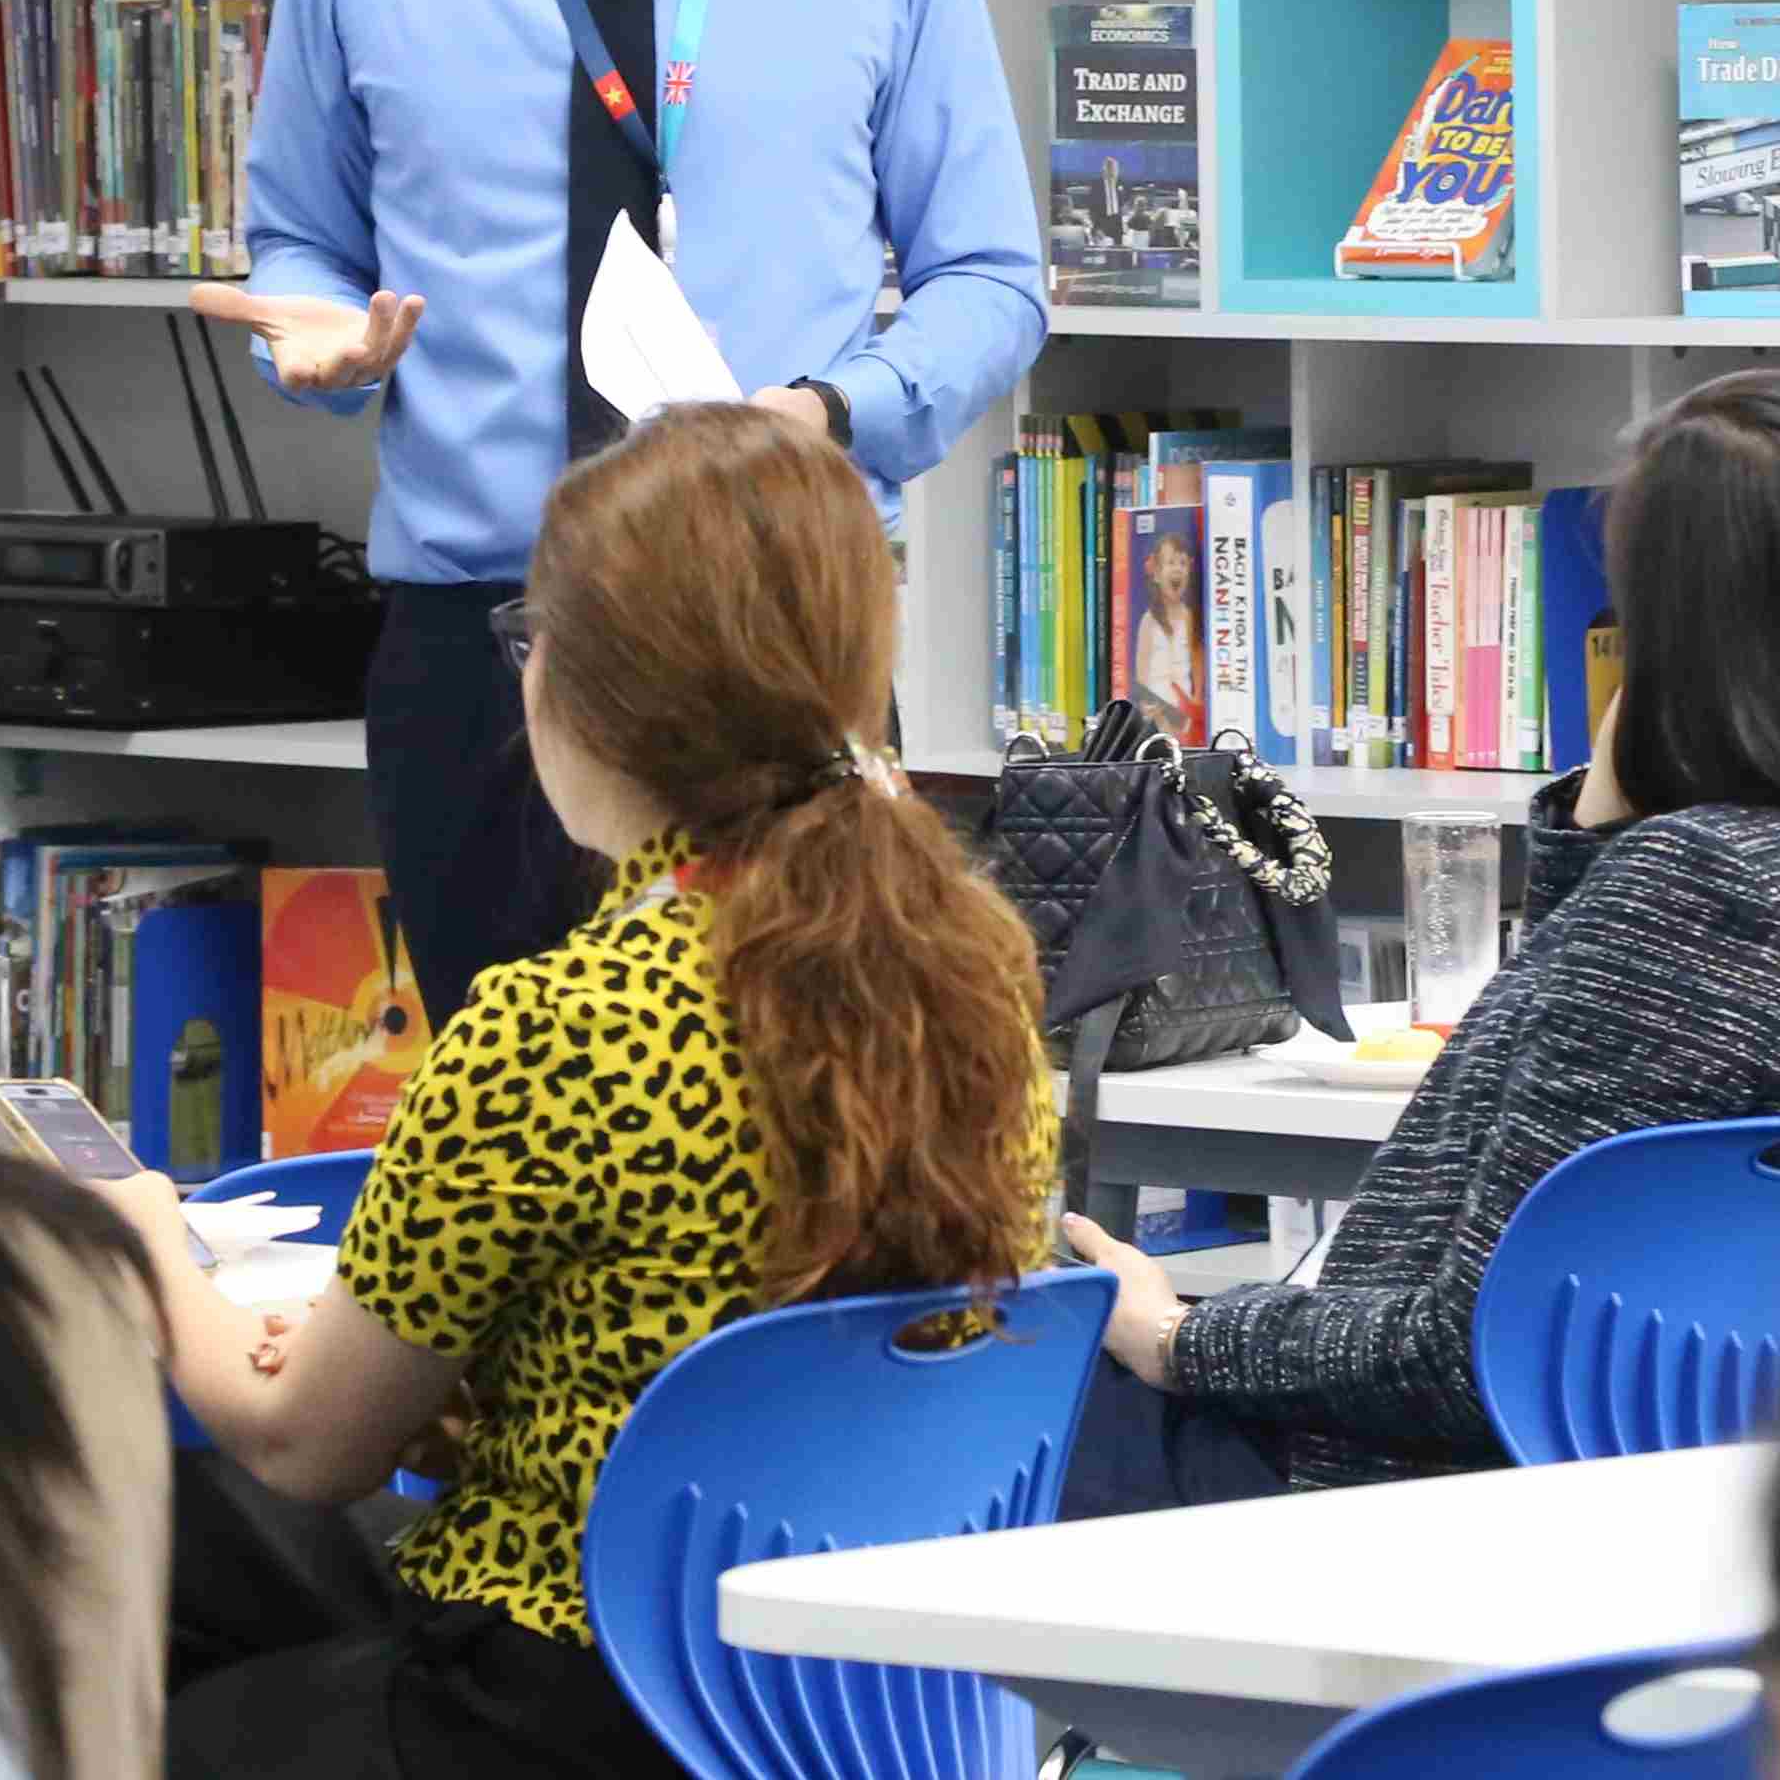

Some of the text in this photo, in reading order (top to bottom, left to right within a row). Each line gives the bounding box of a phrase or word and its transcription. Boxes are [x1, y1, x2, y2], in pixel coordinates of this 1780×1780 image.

[1707, 37, 1740, 50] How
[1073, 67, 1187, 93] TRADE AND
[1696, 56, 1758, 83] Trade
[1075, 98, 1186, 124] EXCHANGE
[1439, 128, 1506, 156] TO BE
[1396, 161, 1506, 206] YOU
[1696, 157, 1766, 190] Slowing
[1235, 596, 1248, 648] KHOA
